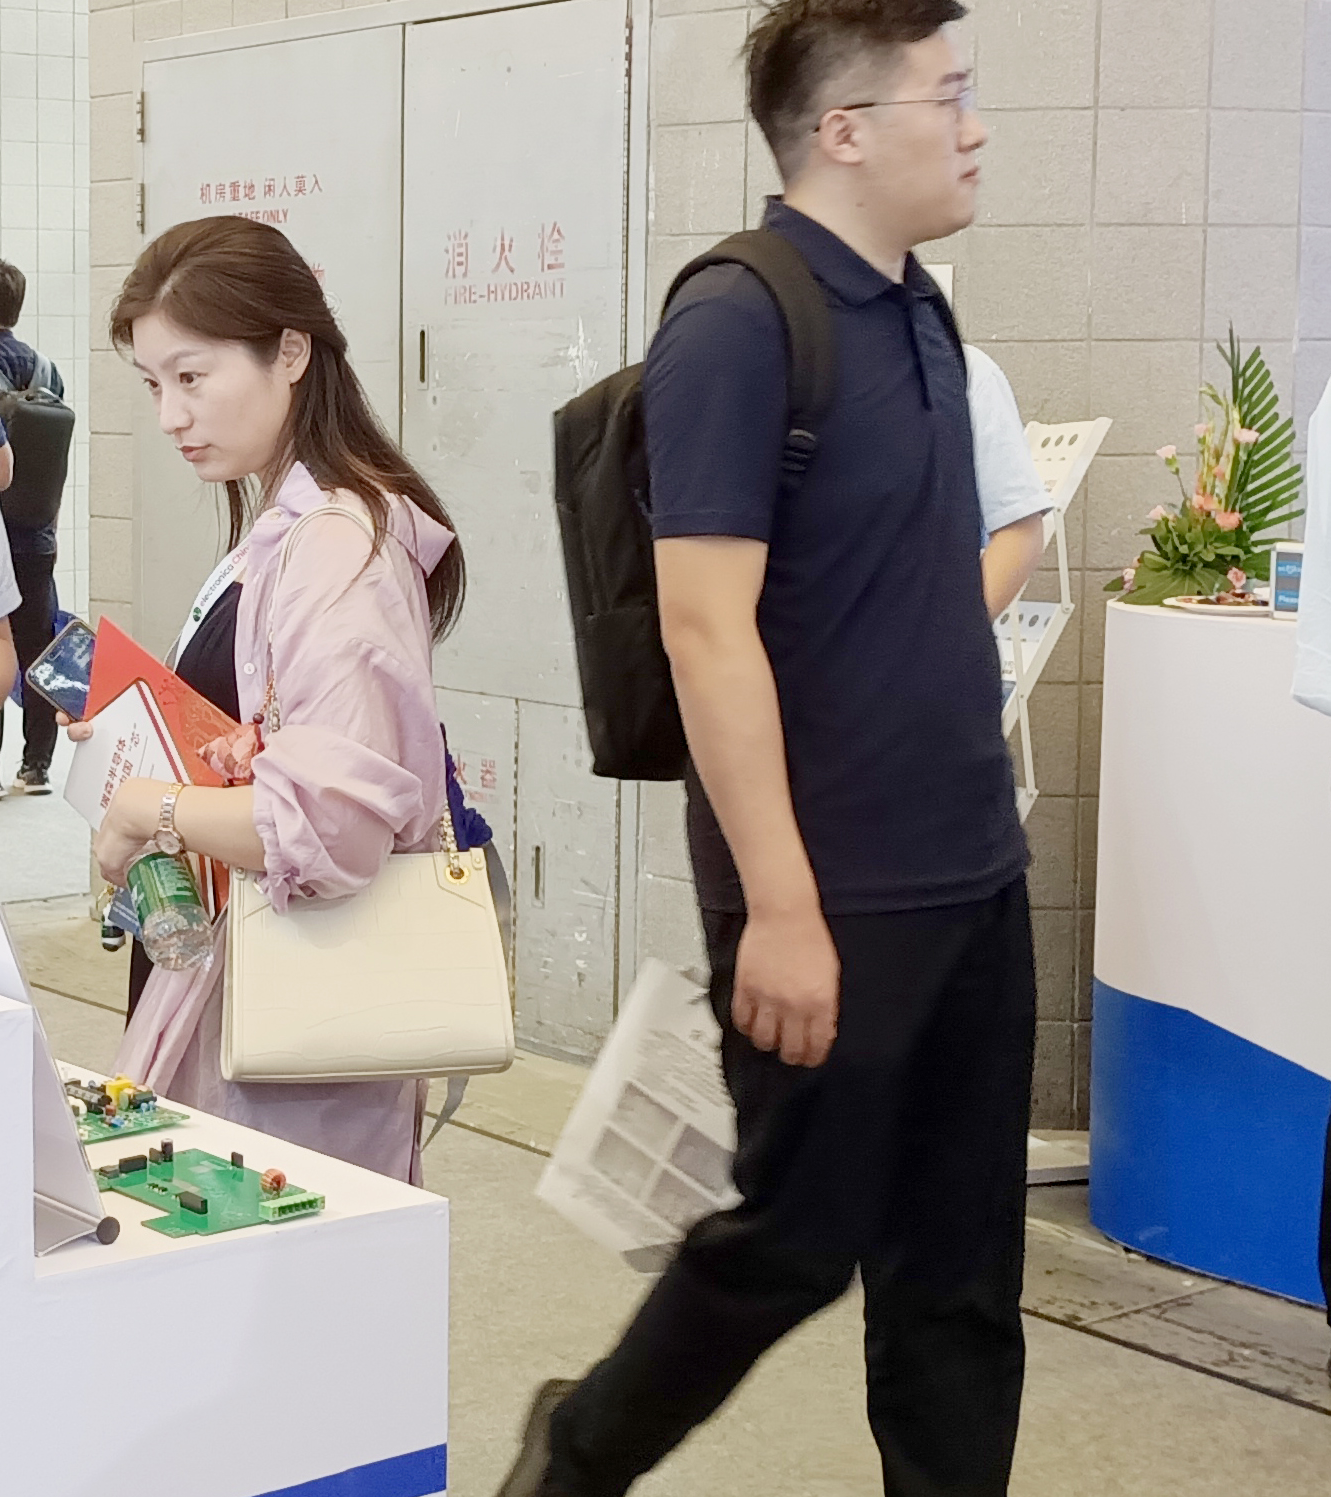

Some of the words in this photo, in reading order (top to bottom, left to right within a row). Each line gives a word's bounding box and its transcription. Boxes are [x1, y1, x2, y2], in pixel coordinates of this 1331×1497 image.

[200, 181, 256, 204] 机房重地
[263, 174, 323, 199] 闲人莫入
[262, 208, 289, 224] ONLY
[444, 221, 565, 279] 消火栓
[444, 278, 566, 305] FIRE-HYDRANT
[200, 563, 234, 607] electronica
